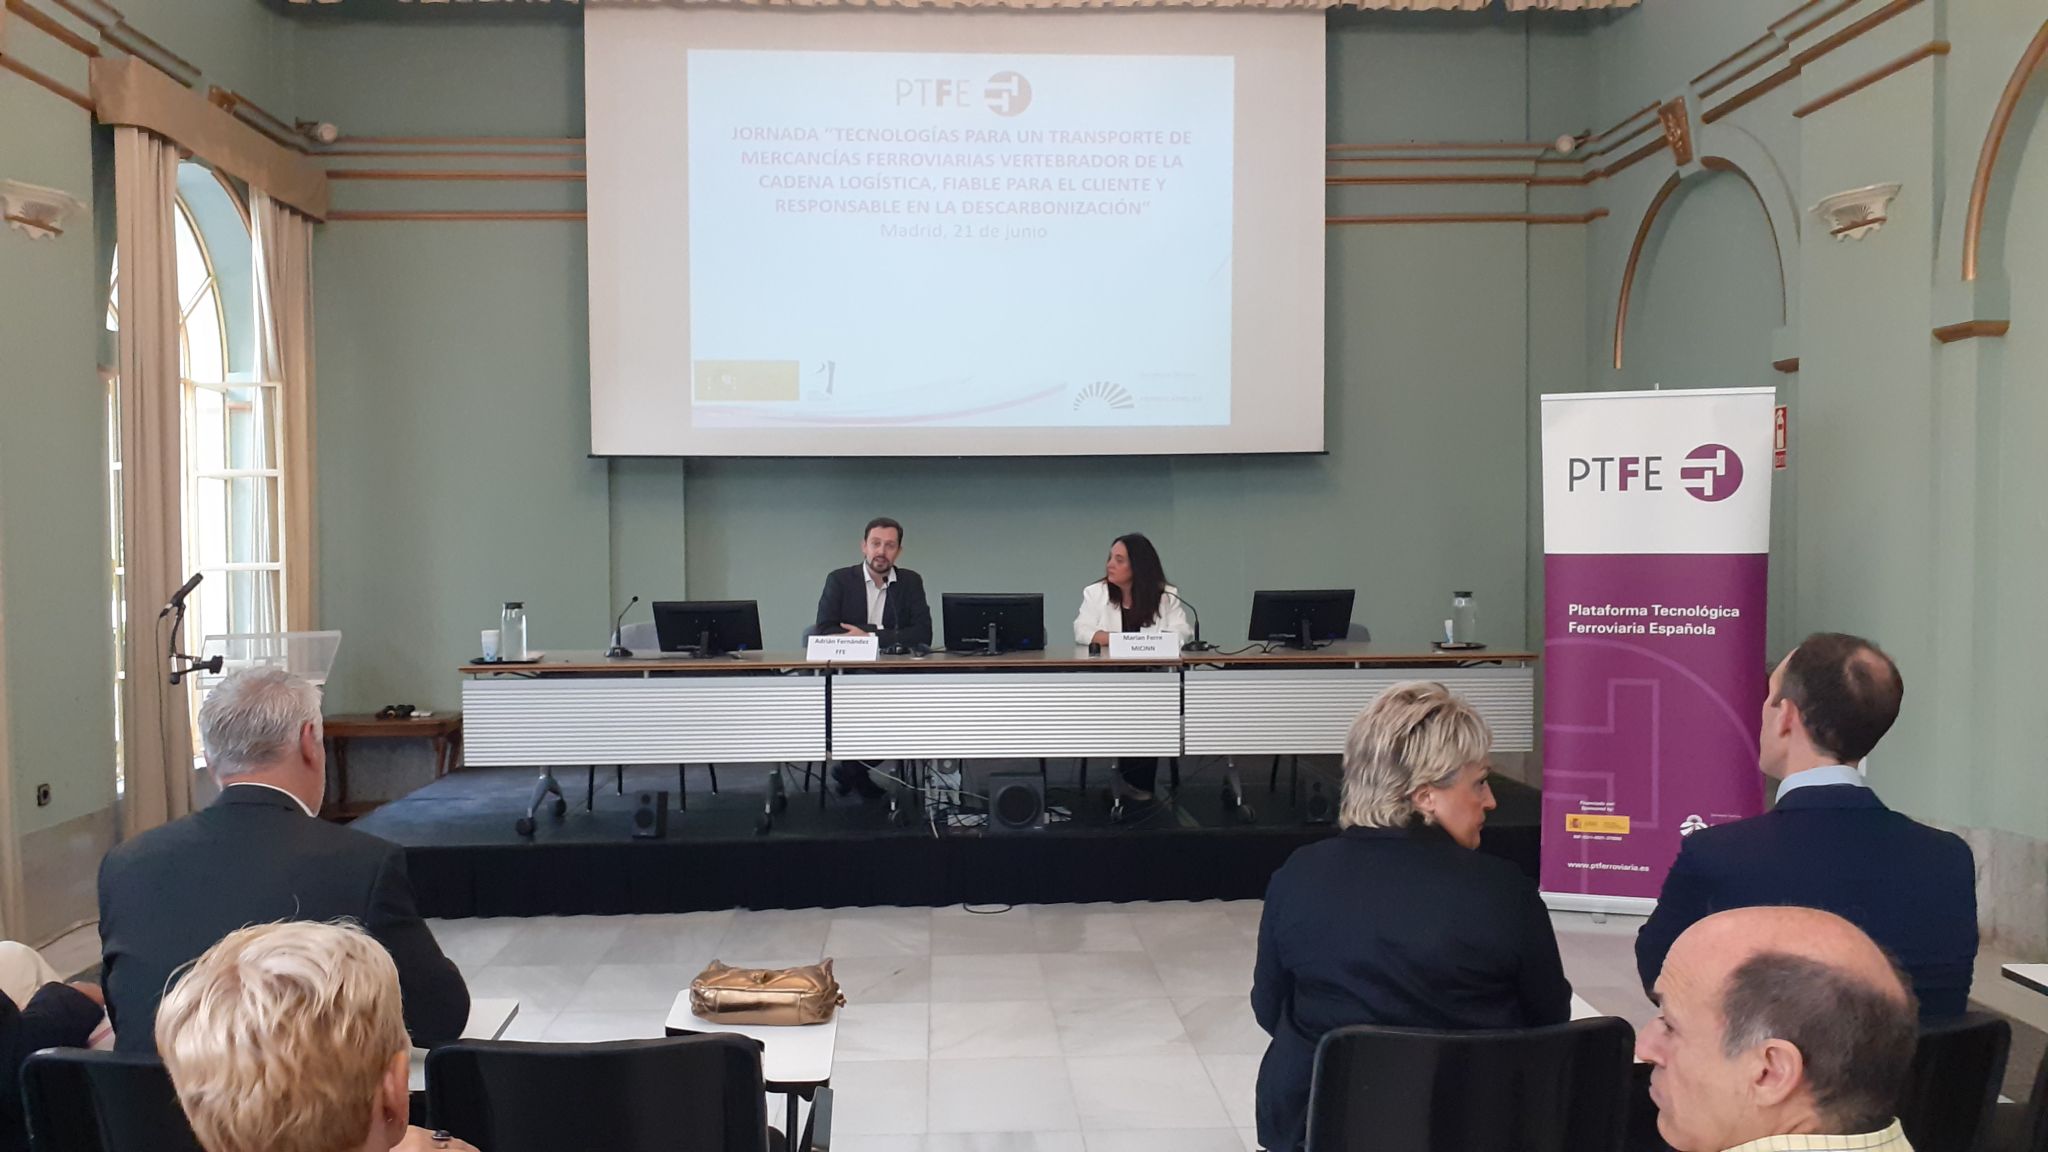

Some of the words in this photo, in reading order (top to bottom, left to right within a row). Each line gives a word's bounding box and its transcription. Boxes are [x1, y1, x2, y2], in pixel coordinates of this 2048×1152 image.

[896, 79, 970, 107] PTFE
[731, 126, 819, 142] JORNADA
[965, 130, 1012, 144] PARA
[1017, 130, 1043, 144] UN
[1049, 130, 1164, 145] TRANSPORTE
[1169, 130, 1192, 144] DE
[741, 149, 861, 167] MERCANCÍAS
[866, 152, 995, 168] FERROVIARIAS
[1000, 153, 1129, 168] VERTEBRADOR
[1135, 154, 1158, 168] DE
[1163, 154, 1184, 169] LA
[759, 175, 834, 190] CADENA
[840, 172, 937, 193] LOGÍSTICA,
[943, 176, 1001, 191] FIABLE
[1006, 177, 1053, 191] PARA
[1058, 177, 1077, 191] EL
[1081, 177, 1151, 191] CLIENTE
[1156, 177, 1167, 192] Y
[775, 198, 902, 214] RESPONSABLE
[907, 199, 930, 214] EN
[935, 200, 957, 215] LA
[880, 222, 947, 241] Madrid,
[953, 224, 974, 238] 21
[979, 223, 1001, 238] de
[1005, 223, 1048, 242] junio
[1569, 456, 1663, 492] PTFE
[1568, 604, 1648, 616] Plataforma
[1651, 604, 1740, 619] Tecnológica
[1568, 621, 1645, 634] Ferroviaria
[1650, 623, 1716, 636] Española
[1567, 862, 1650, 872] www.ptferroviaria.es
